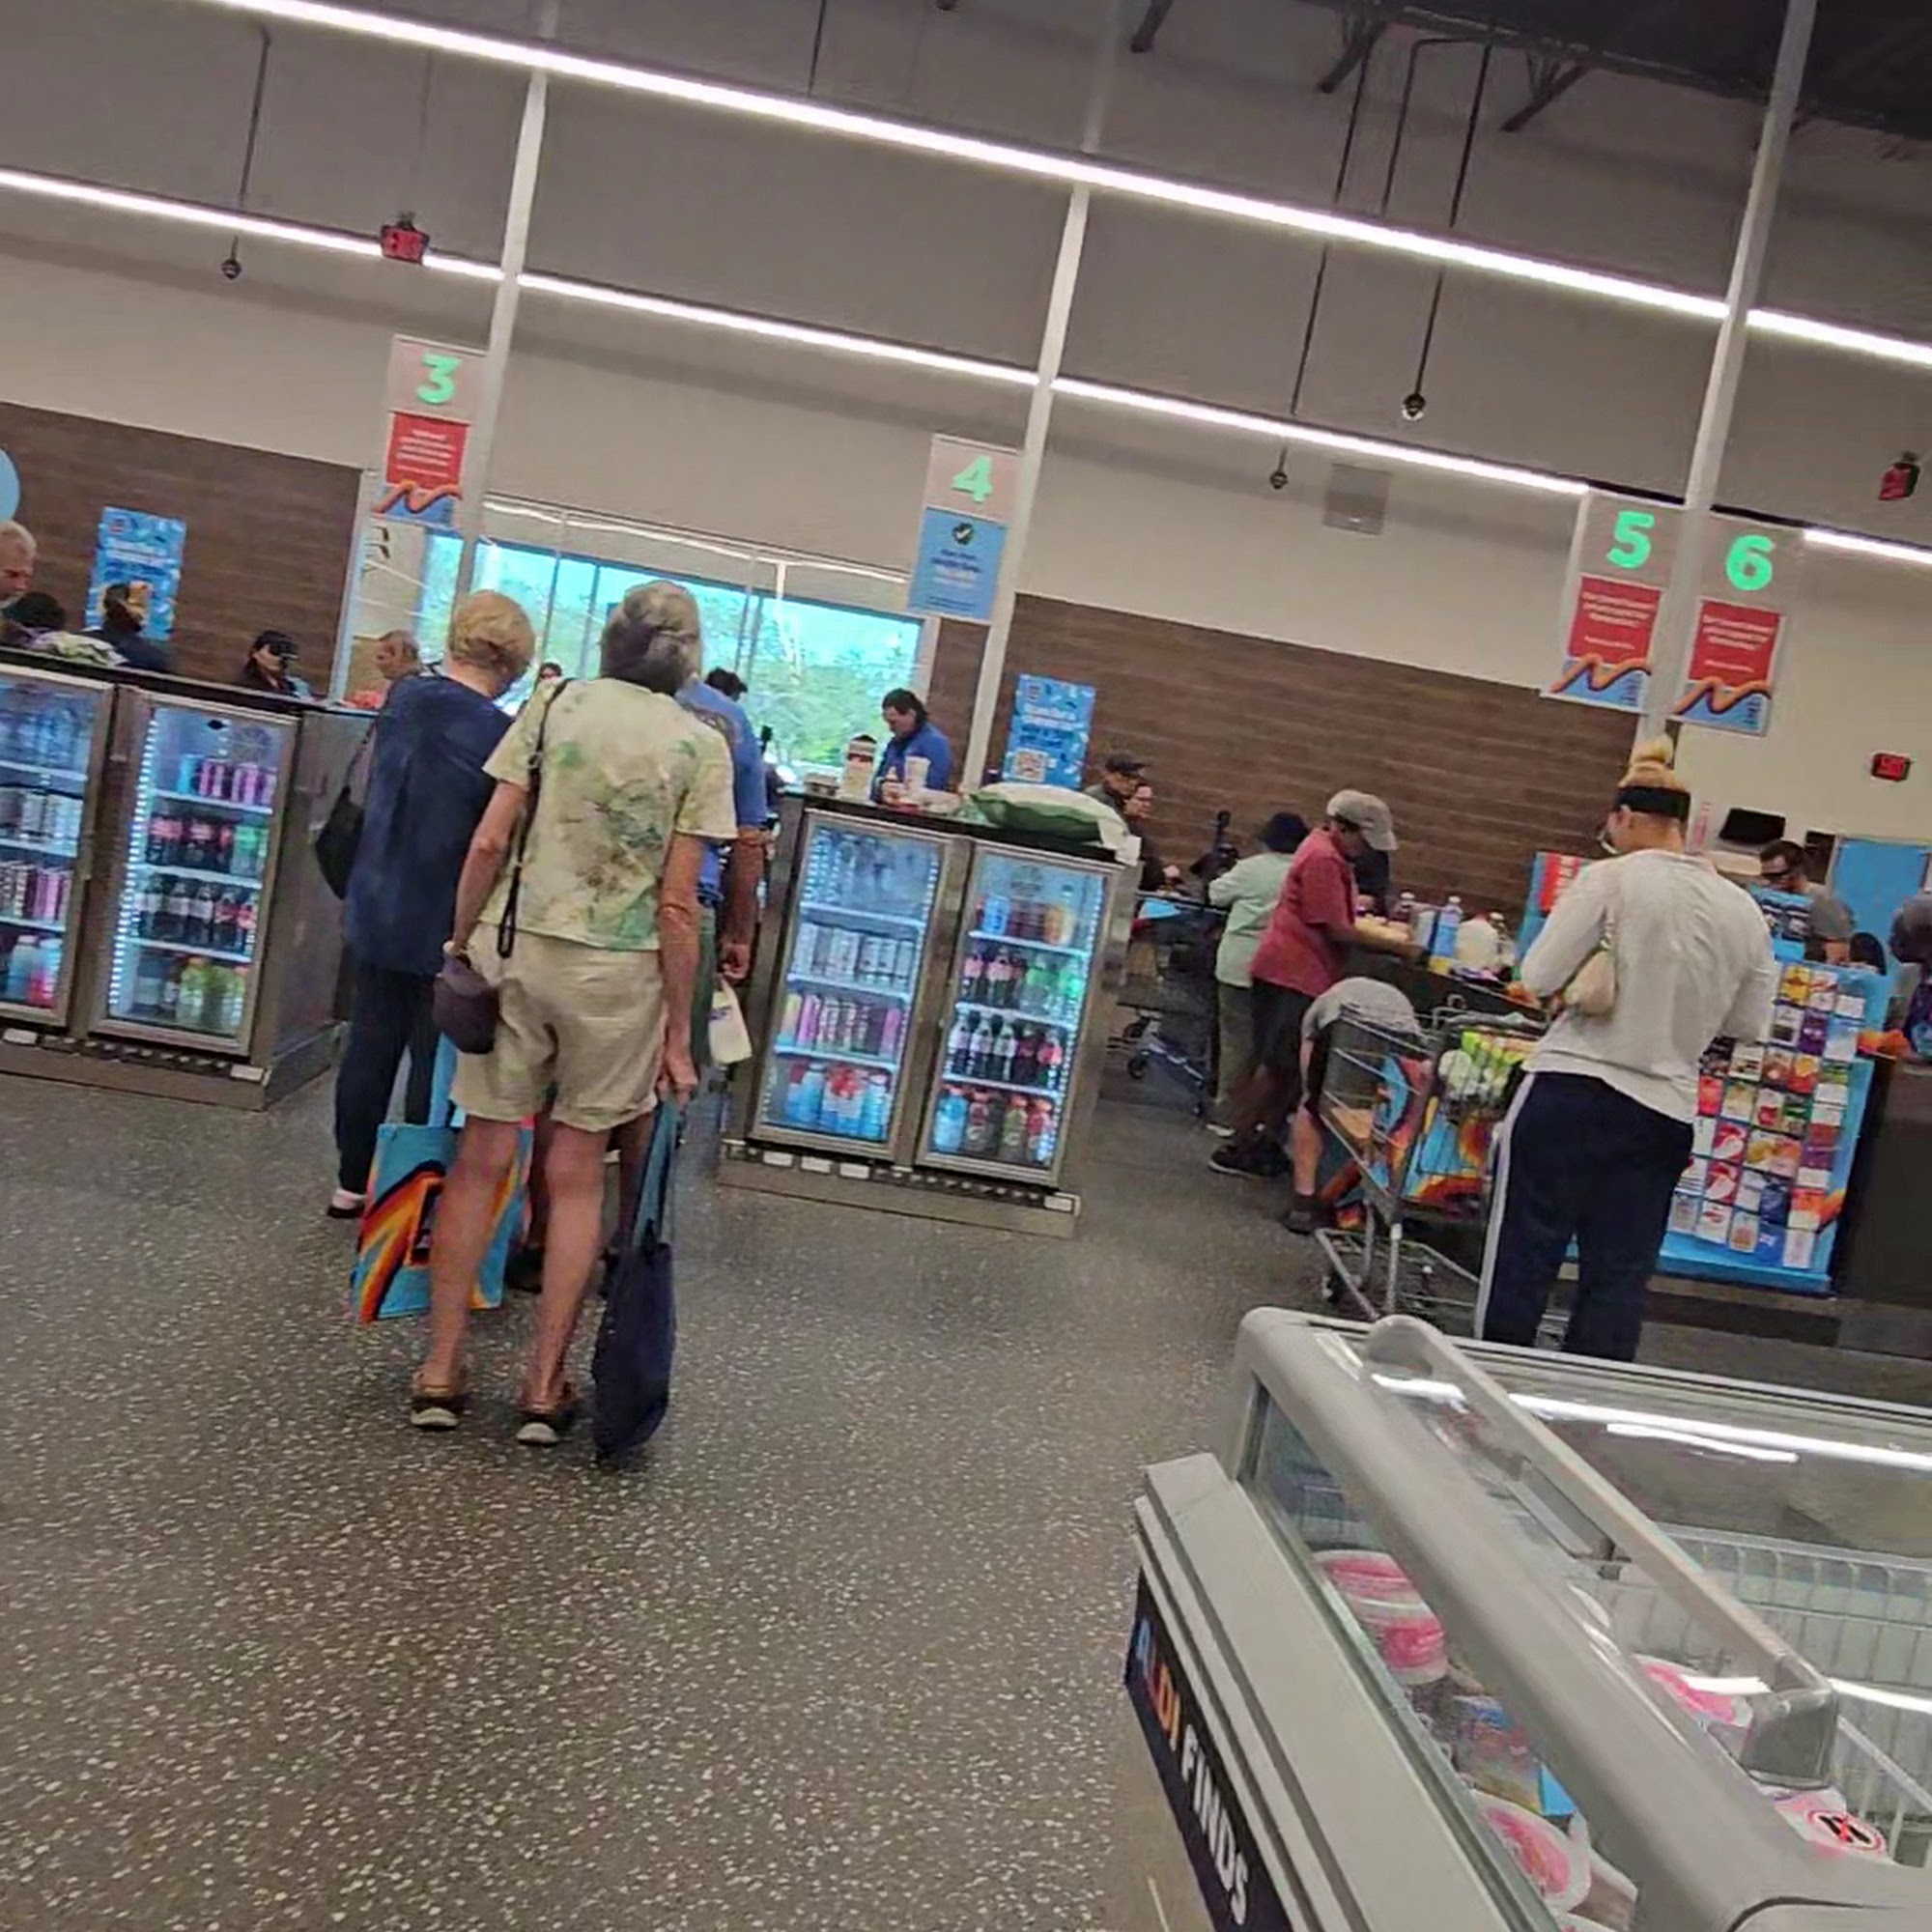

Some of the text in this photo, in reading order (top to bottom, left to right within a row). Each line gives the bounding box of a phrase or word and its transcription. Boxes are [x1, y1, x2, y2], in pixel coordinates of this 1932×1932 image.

[416, 352, 462, 405] 3
[951, 454, 994, 504] 4
[1606, 510, 1655, 569] 5
[1725, 534, 1775, 591] 6
[1180, 1722, 1249, 1926] FINDS
